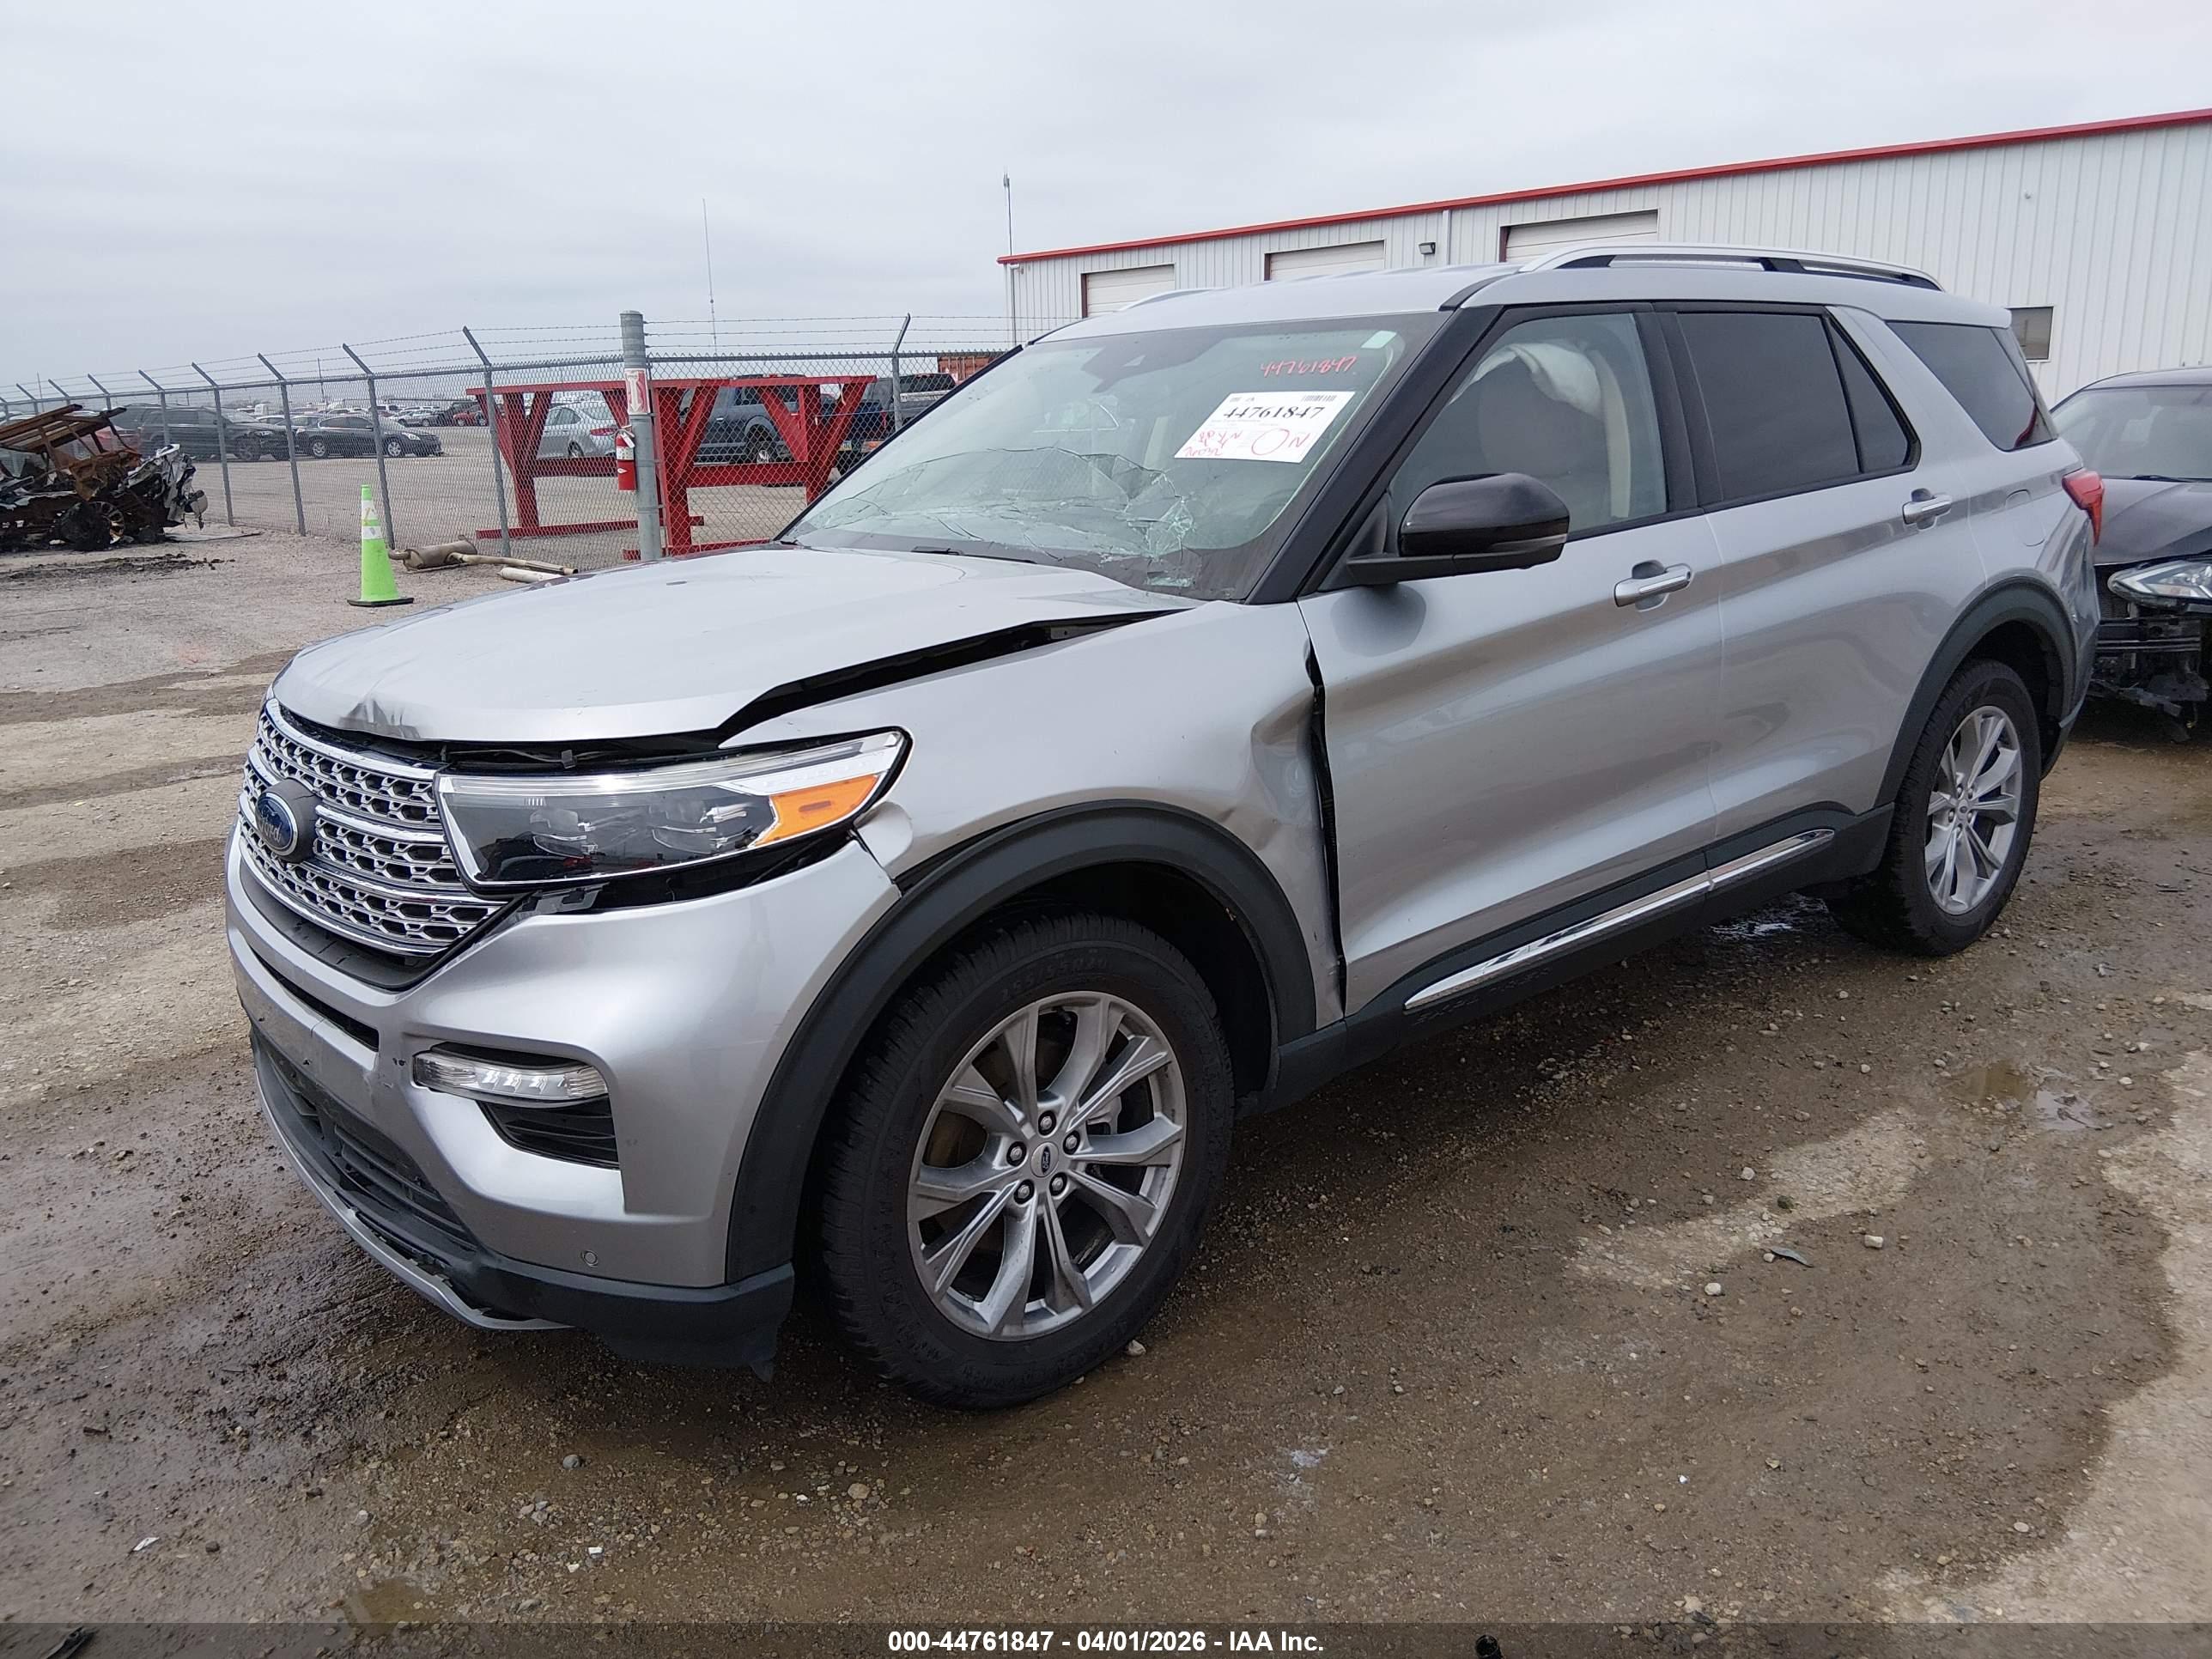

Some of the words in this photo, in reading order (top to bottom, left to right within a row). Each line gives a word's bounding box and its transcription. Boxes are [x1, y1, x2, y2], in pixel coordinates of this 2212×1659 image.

[1260, 356, 1358, 377] 44761847
[1223, 406, 1325, 419] 44761847
[259, 805, 283, 842] Ford
